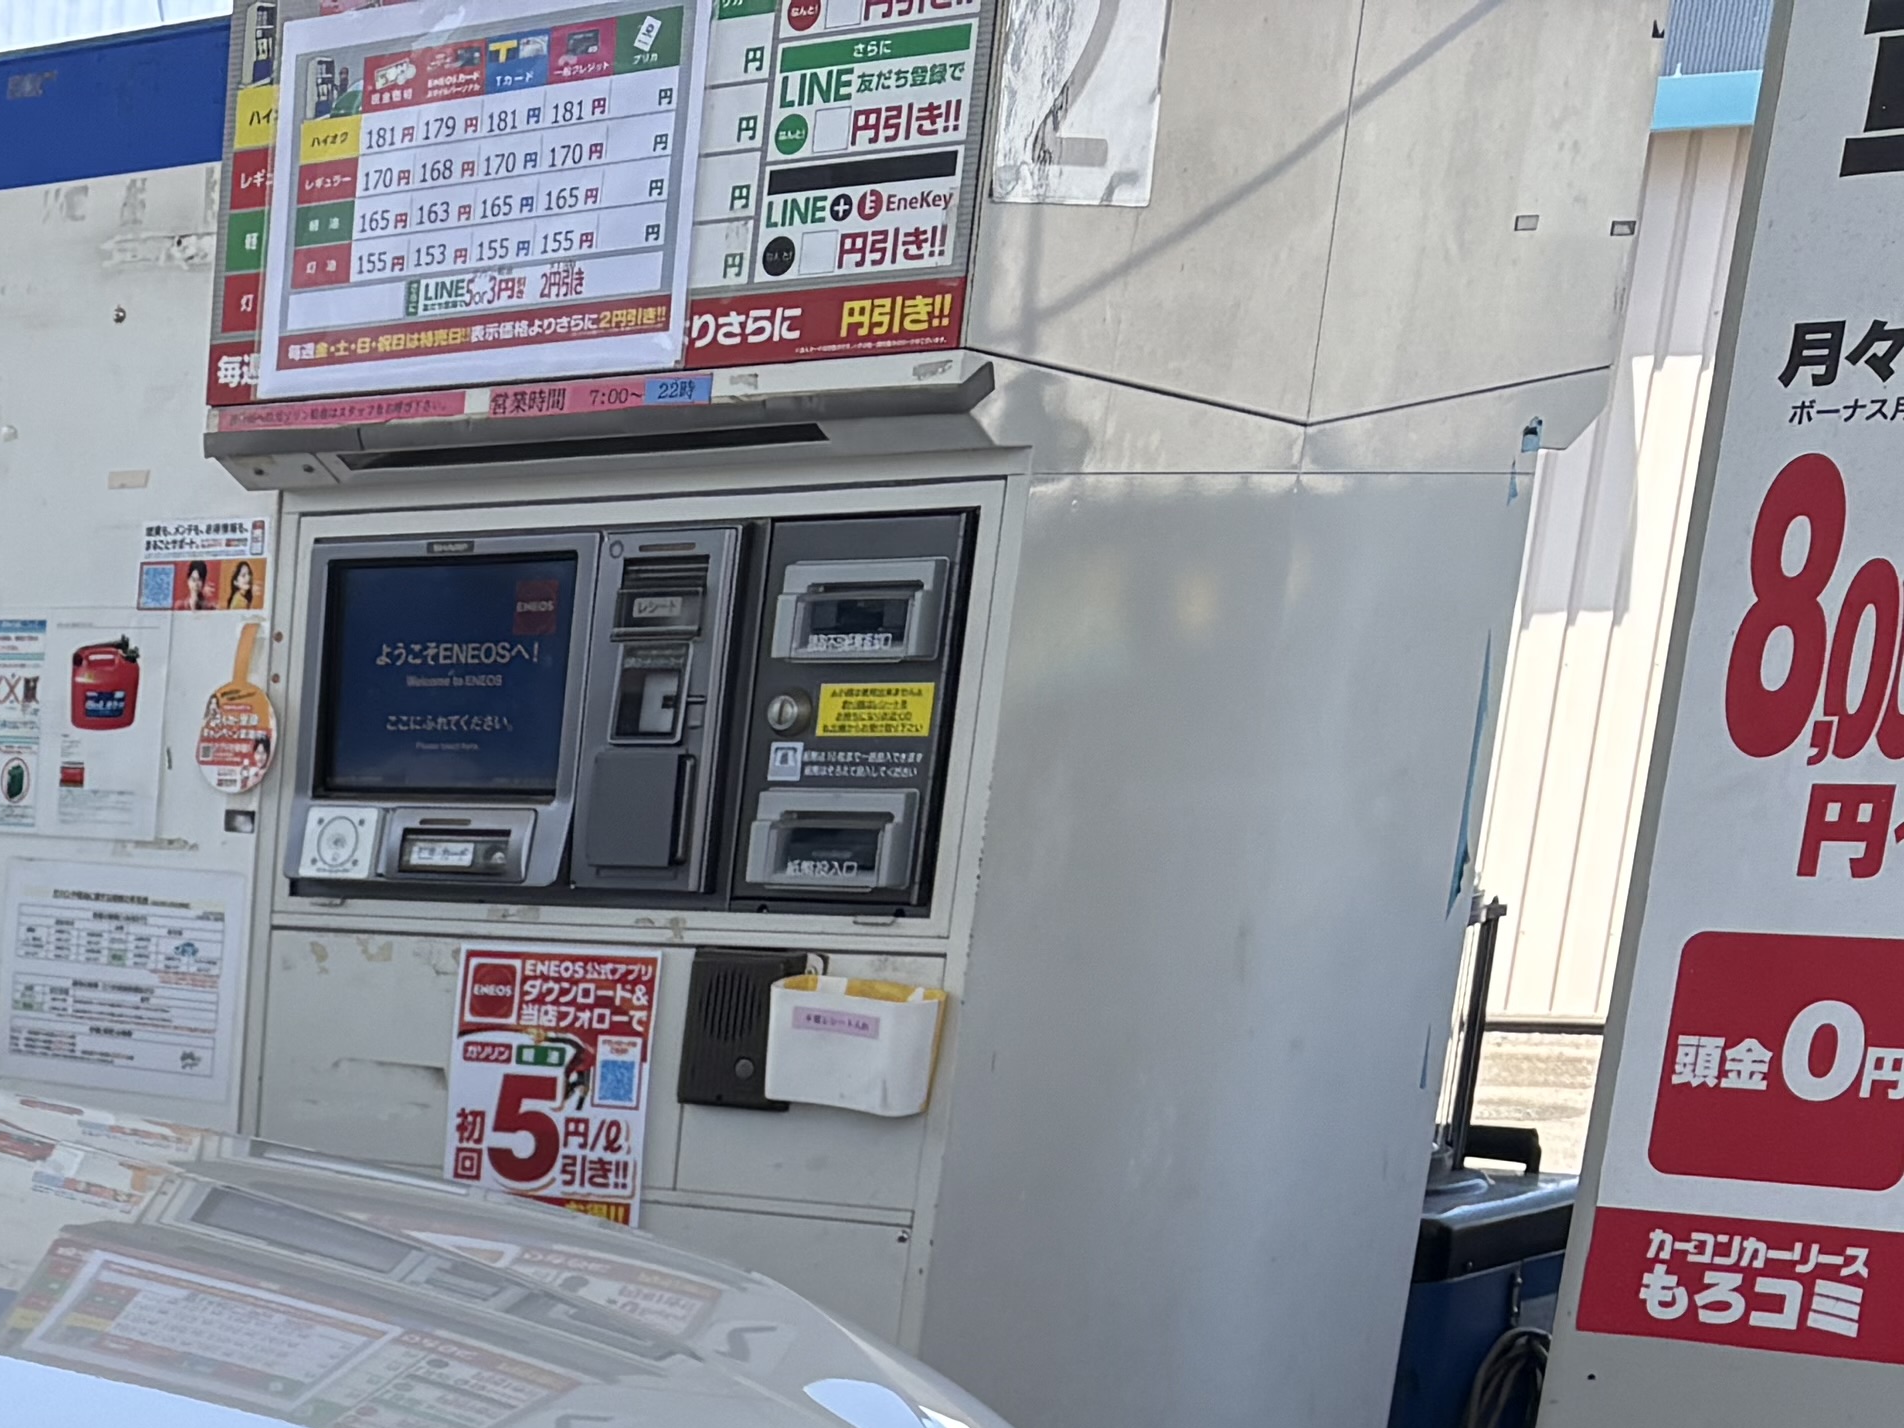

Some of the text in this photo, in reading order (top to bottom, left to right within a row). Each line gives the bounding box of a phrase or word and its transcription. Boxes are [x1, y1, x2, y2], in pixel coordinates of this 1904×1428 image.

[744, 46, 765, 74] 円
[853, 41, 892, 57] さらに
[658, 87, 673, 106] 円
[779, 61, 966, 109] LINE 友だち登録で
[249, 108, 277, 125] ハイ
[487, 107, 541, 133] 181 円
[551, 97, 606, 125] 181 円
[850, 99, 962, 147] 円引き!!
[366, 125, 415, 150] 181 円
[424, 116, 479, 140] 179 円
[737, 115, 758, 142] 円
[548, 142, 604, 168] 170 円
[653, 133, 668, 152] 円
[420, 159, 475, 182] 168 円
[484, 151, 538, 176] 170 円
[363, 167, 411, 191] 170 円
[648, 178, 664, 197] 円
[480, 195, 534, 219] 165 円
[545, 186, 599, 210] 165 円
[729, 184, 751, 211] 円
[765, 190, 954, 228] LINE EneKey
[359, 210, 408, 233] 165 円
[415, 202, 472, 225] 163 円
[541, 230, 594, 255] 155 円
[645, 223, 661, 242] 円
[413, 244, 468, 267] 153 円
[477, 238, 531, 262] 155 円
[838, 225, 948, 269] 円引き!!
[357, 252, 405, 274] 155 円
[723, 252, 744, 279] 円
[424, 277, 465, 301] LINE
[685, 306, 802, 348] りさらに
[840, 293, 952, 338] 円引き!!
[491, 387, 567, 415] 営業時間
[657, 380, 695, 400] 22時
[516, 600, 555, 613] ENEOS
[1725, 452, 1904, 766] 8,0
[1796, 783, 1904, 879] 円
[473, 984, 513, 997] ENEOS
[522, 981, 649, 1006] ダウンロード&
[519, 1003, 648, 1032] 当店フォローで
[487, 1073, 560, 1183] 5
[453, 1107, 486, 1182] 初回
[1646, 1228, 1869, 1280] カーコンカーリース
[1638, 1263, 1863, 1339] もろコミ
